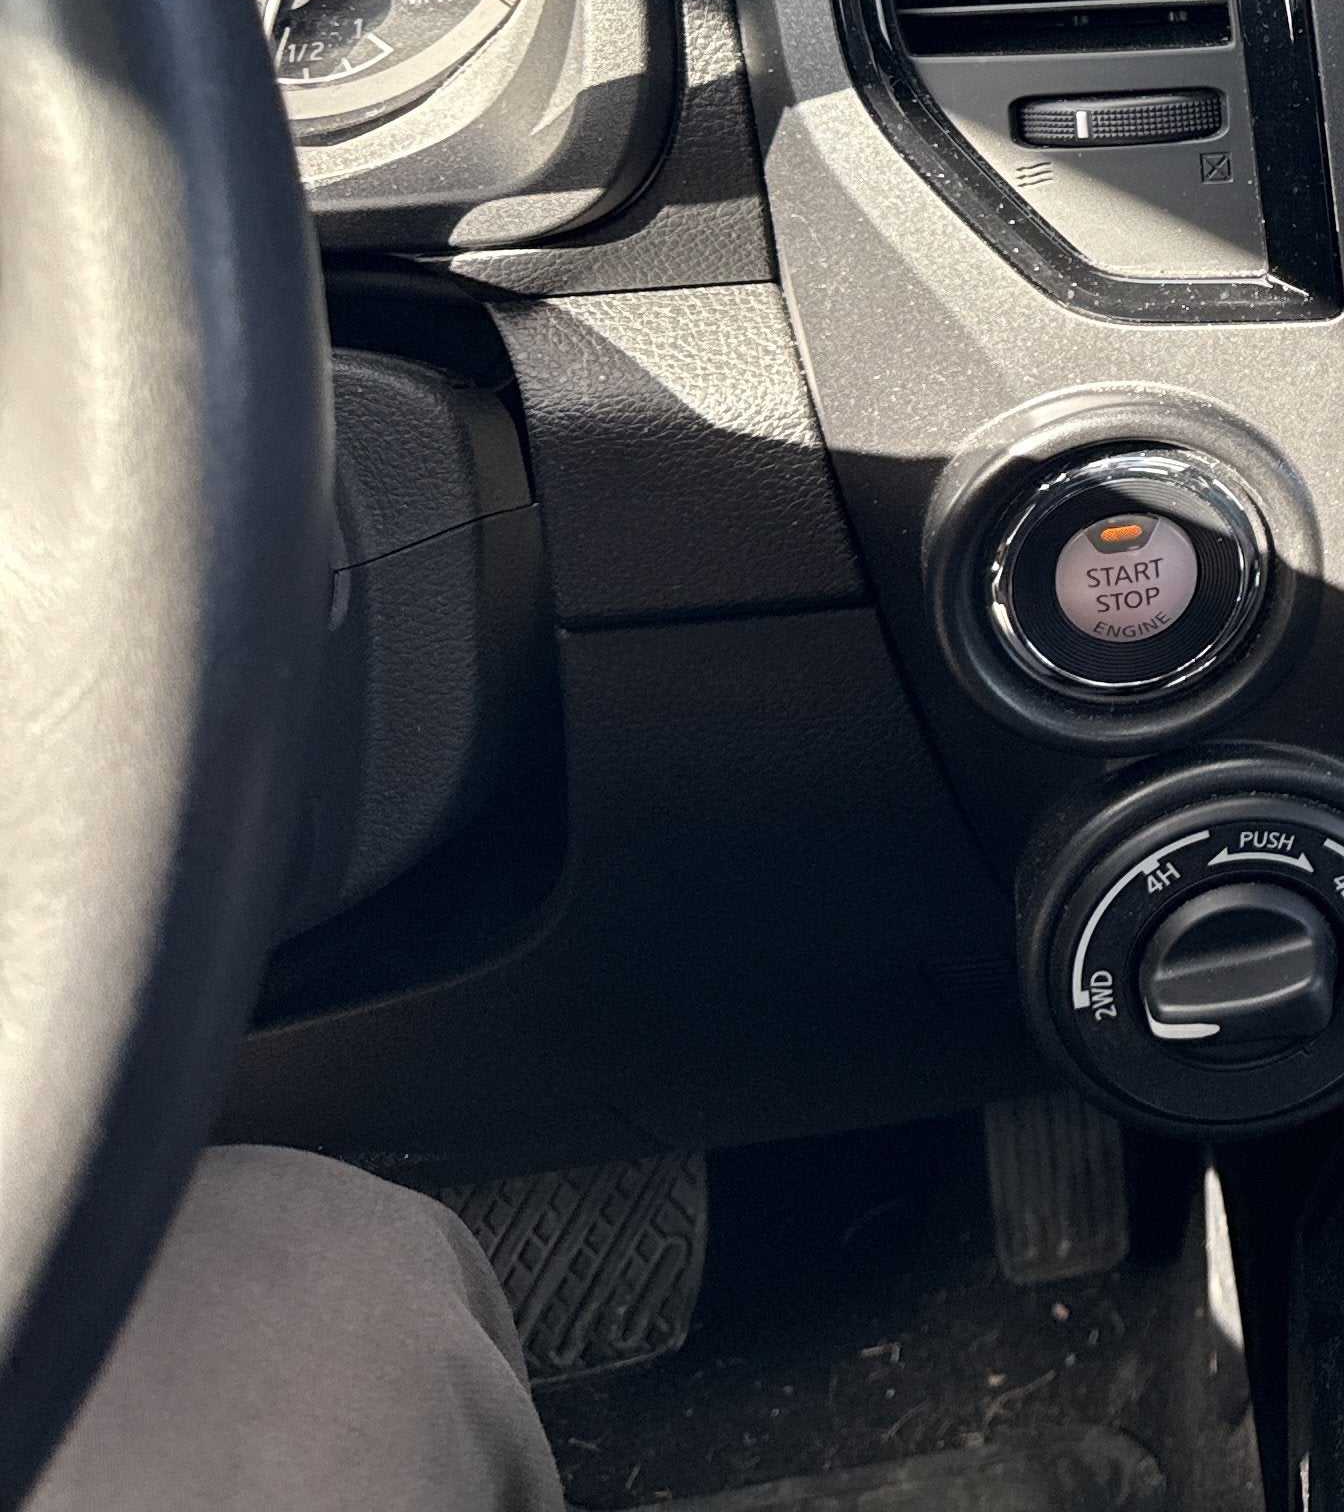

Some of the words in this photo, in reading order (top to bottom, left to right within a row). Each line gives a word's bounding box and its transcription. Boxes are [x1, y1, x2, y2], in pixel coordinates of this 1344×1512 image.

[353, 17, 364, 38] 1
[287, 41, 325, 64] 1/2
[1086, 557, 1164, 589] START
[1095, 586, 1161, 614] STOP
[1092, 609, 1172, 639] ENGINE
[1238, 830, 1296, 853] PUSH
[1144, 861, 1182, 895] 4H
[1090, 970, 1118, 1022] 2WD
